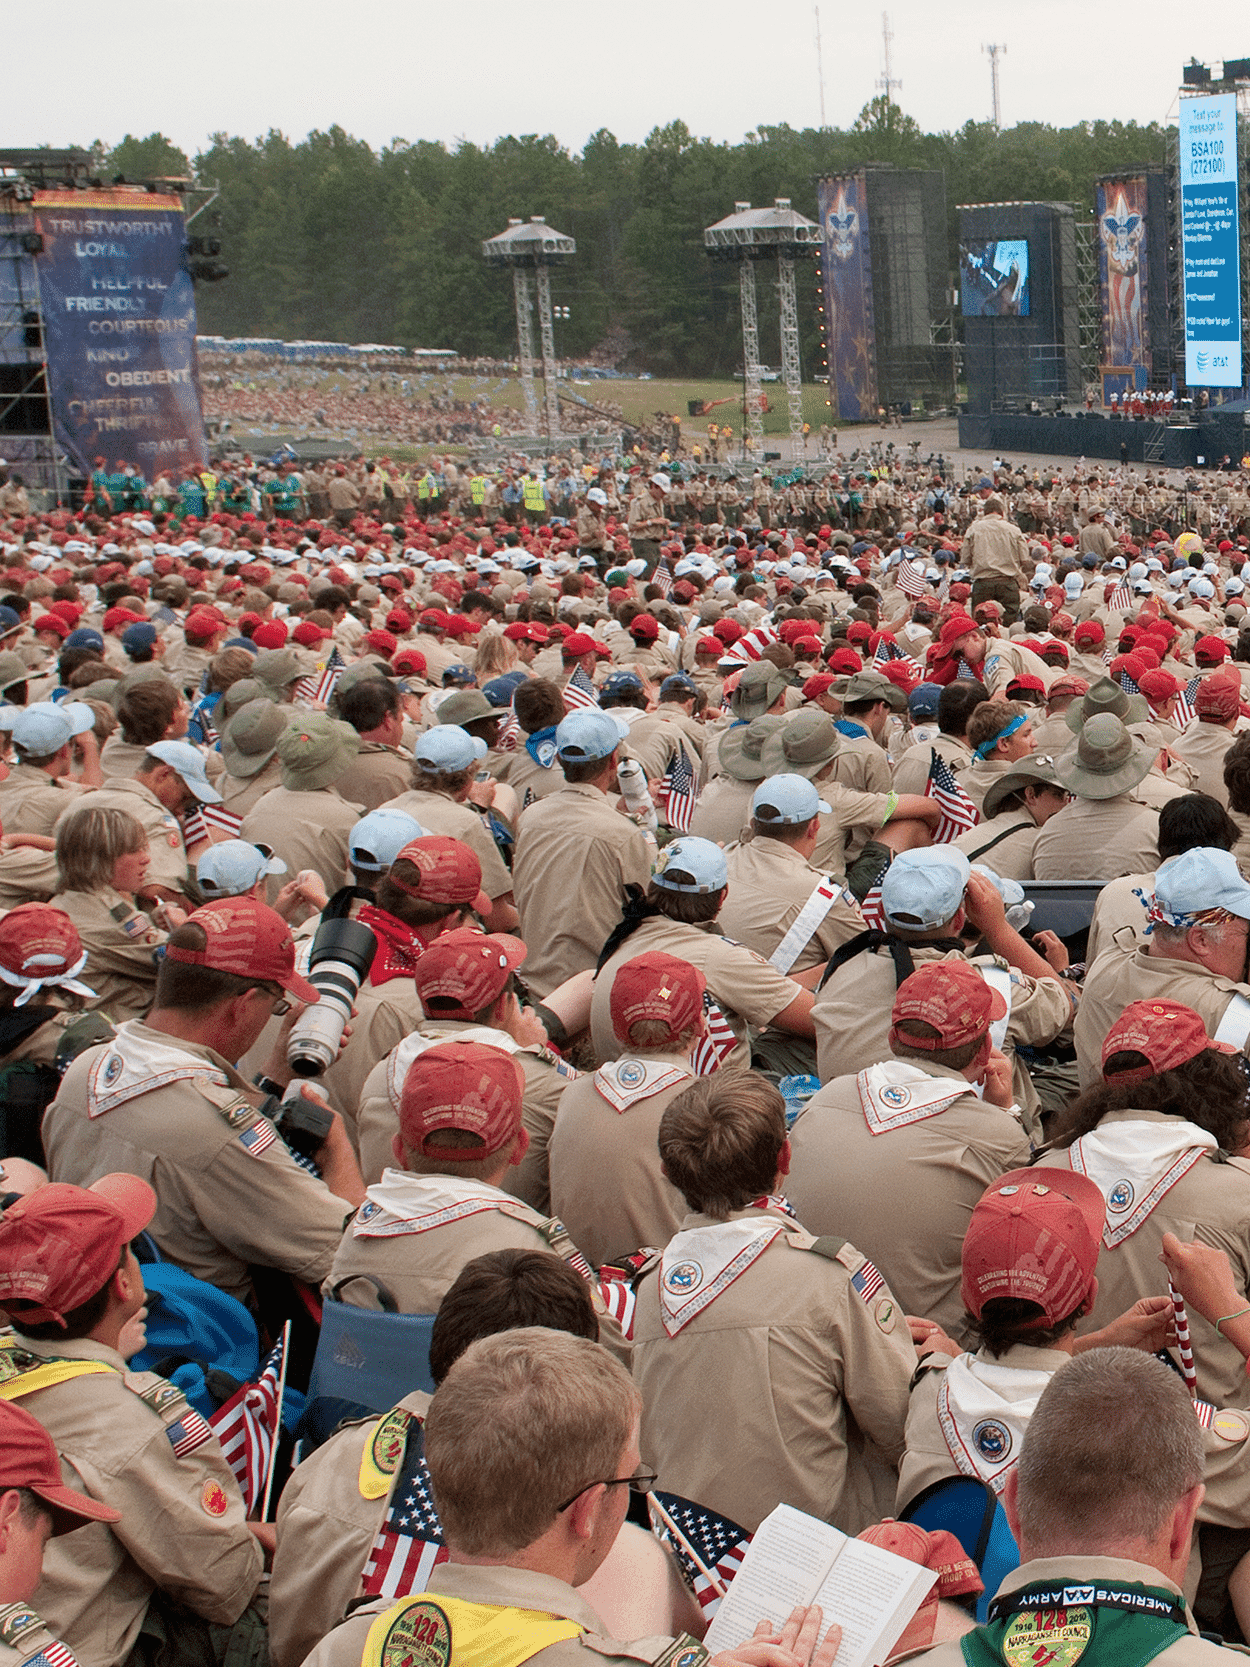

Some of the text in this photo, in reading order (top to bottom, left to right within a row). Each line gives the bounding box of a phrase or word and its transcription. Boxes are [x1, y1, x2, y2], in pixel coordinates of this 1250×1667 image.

[1191, 140, 1224, 157] BSA100
[1190, 157, 1226, 178] (272100)
[49, 219, 173, 236] TRUSTWORTHY
[66, 297, 146, 312] FRIENDLY
[88, 318, 189, 336] COURTEOUS
[105, 369, 191, 387] OBEDIENT
[1018, 1591, 1062, 1606] ARMY
[1096, 1590, 1172, 1614] AMERICA'S
[1014, 1622, 1033, 1631] 1910
[1033, 1608, 1068, 1631] 128
[1068, 1612, 1087, 1623] 2010
[412, 1613, 439, 1646] 128
[1008, 1626, 1062, 1648] NARRAGANSETT
